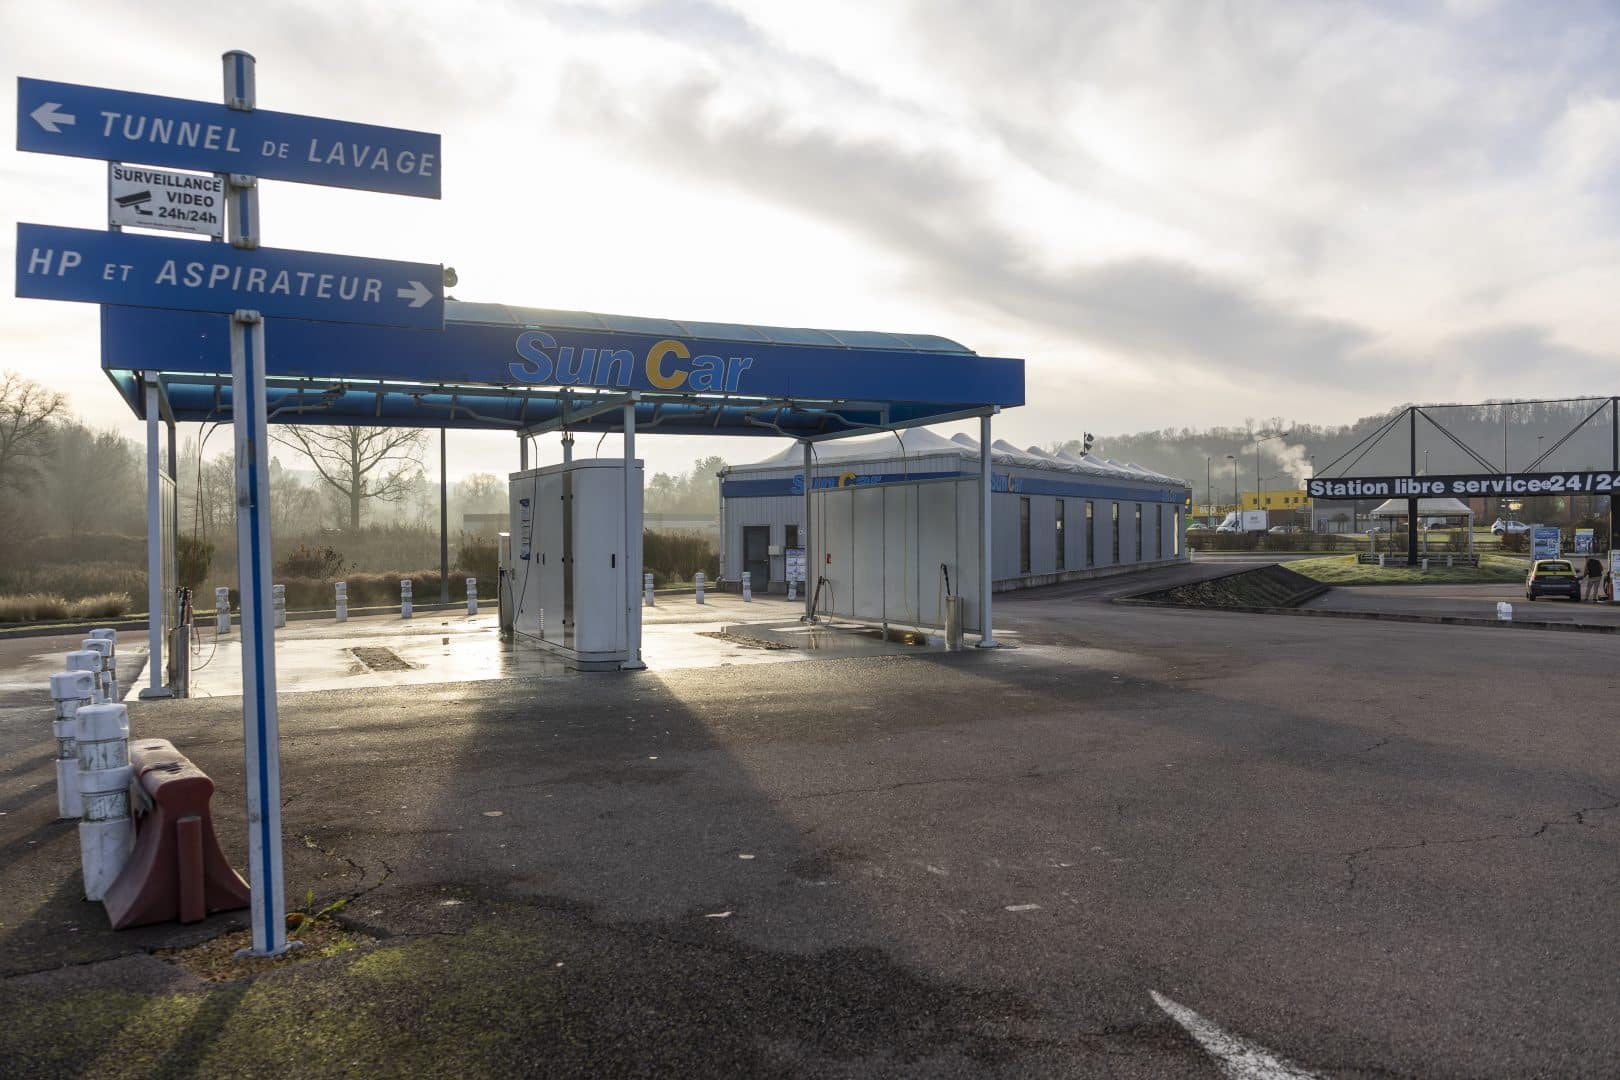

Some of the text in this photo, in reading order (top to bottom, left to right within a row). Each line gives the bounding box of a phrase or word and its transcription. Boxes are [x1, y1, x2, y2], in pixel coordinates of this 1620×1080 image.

[101, 111, 435, 178] TUNNEL DE LAVAGE
[114, 168, 221, 192] SURVEILLANCE
[166, 191, 214, 207] VIDEO
[159, 207, 217, 224] 24h/24h
[28, 247, 382, 303] HP ET ASPIRATEUR
[508, 330, 754, 392] Sun Car
[1310, 480, 1389, 496] Station
[1395, 478, 1445, 494] libre
[1452, 476, 1542, 493] service
